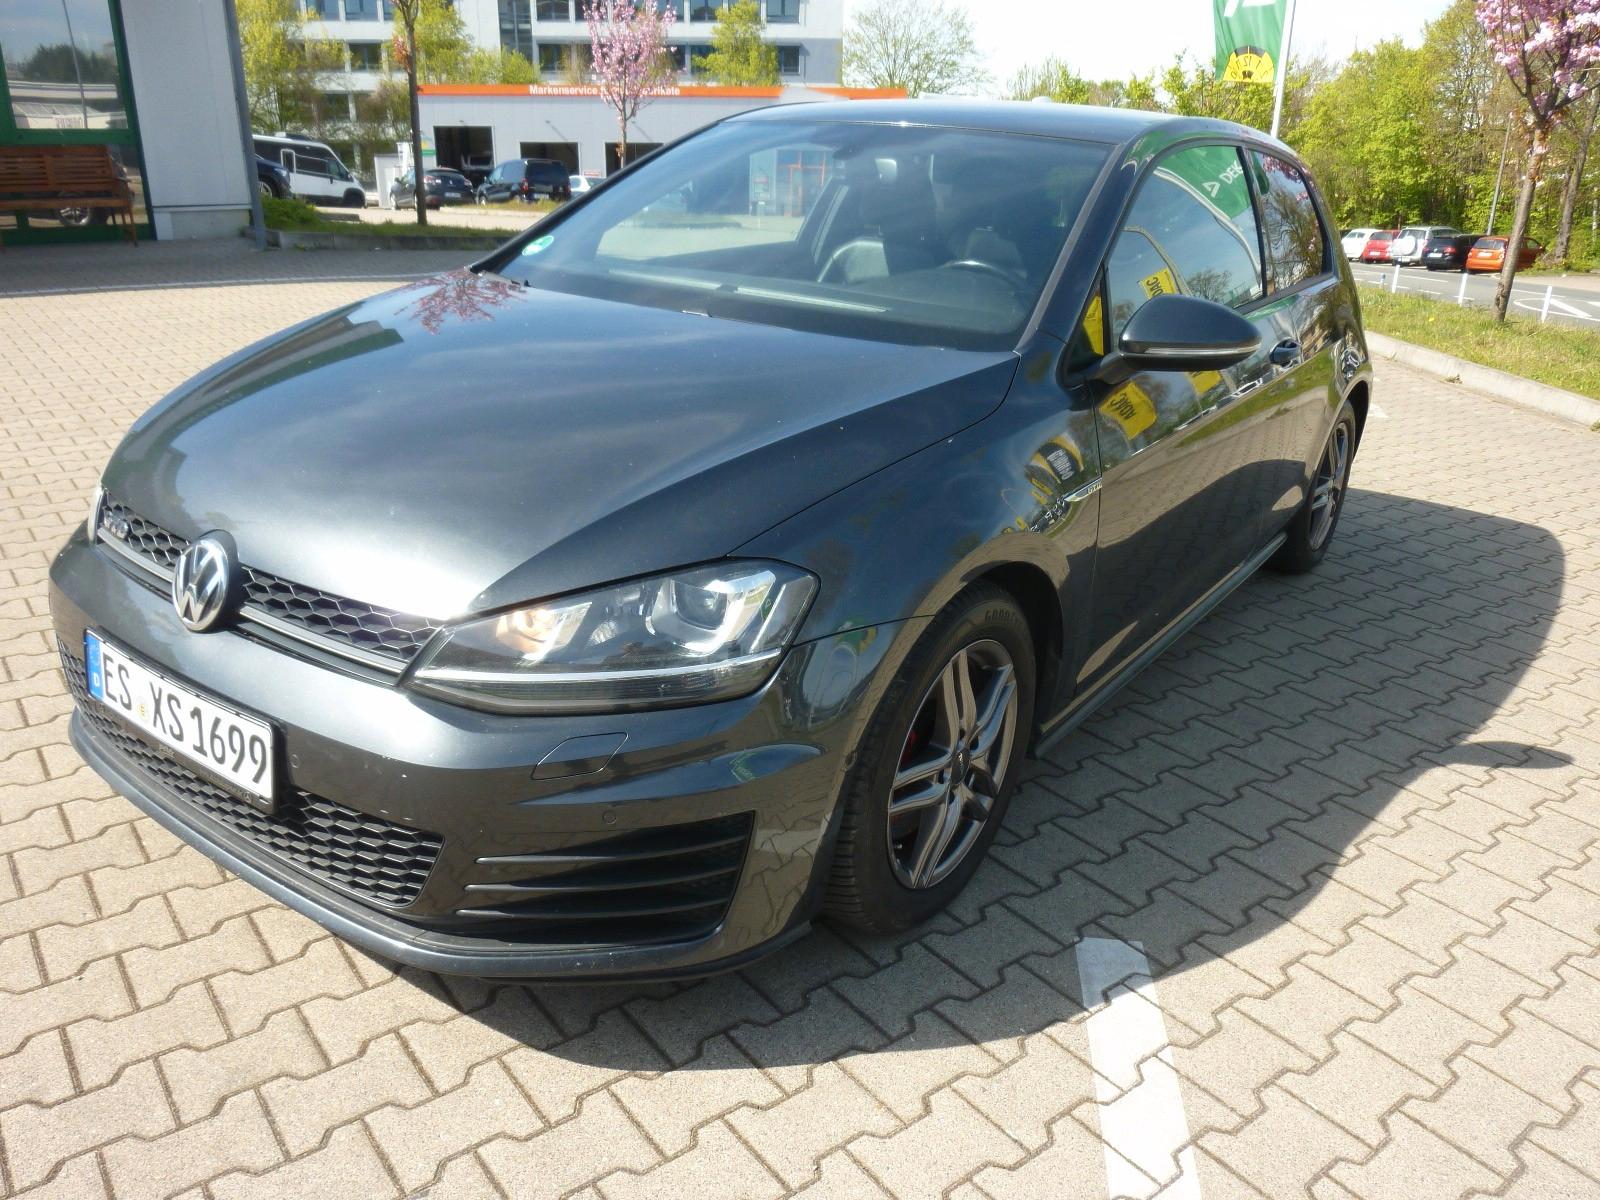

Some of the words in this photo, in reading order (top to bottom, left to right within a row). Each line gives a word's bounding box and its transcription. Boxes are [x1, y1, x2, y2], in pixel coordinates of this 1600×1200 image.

[529, 85, 598, 96] Markenservice
[1219, 159, 1244, 184] DEK
[94, 672, 101, 688] D
[101, 651, 132, 711] ES
